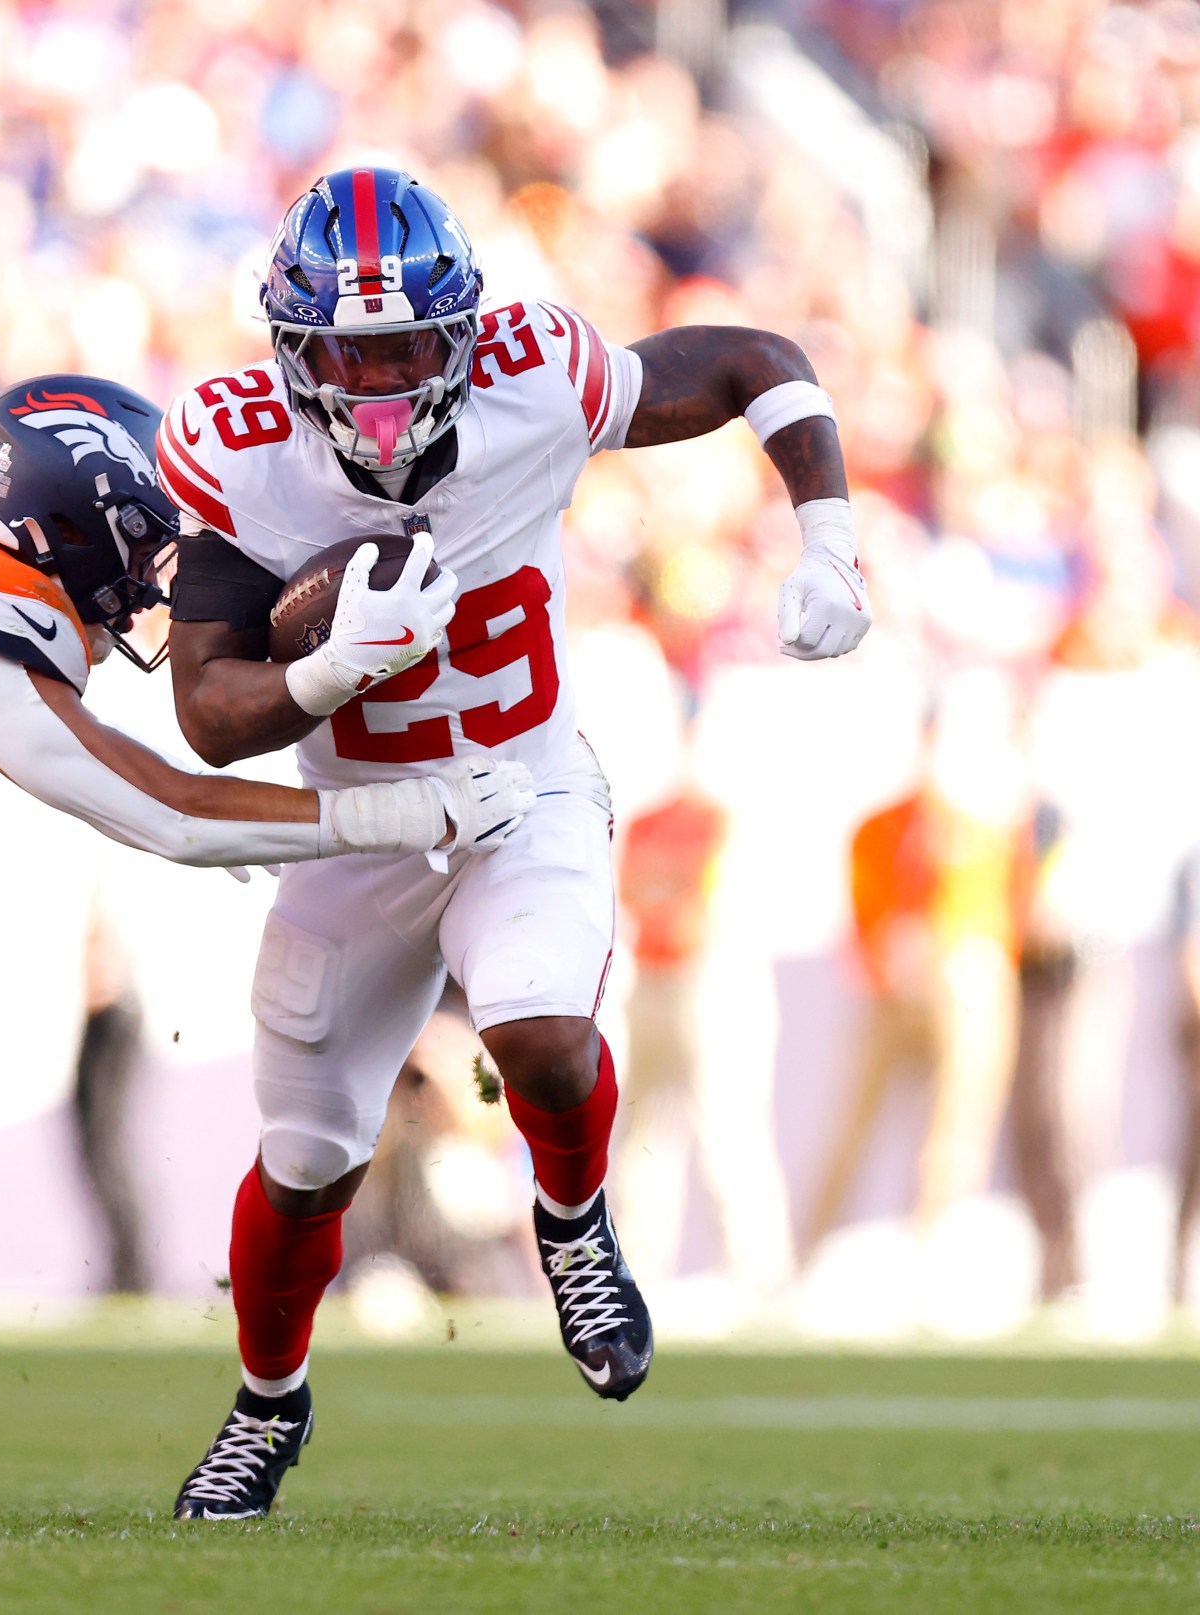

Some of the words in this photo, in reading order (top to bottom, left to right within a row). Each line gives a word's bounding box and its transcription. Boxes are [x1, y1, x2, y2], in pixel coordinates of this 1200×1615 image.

[336, 254, 404, 296] 29
[294, 312, 325, 325] OAKLEY
[430, 302, 458, 318] OAKLEY
[193, 368, 293, 452] 29
[330, 564, 561, 764] 29
